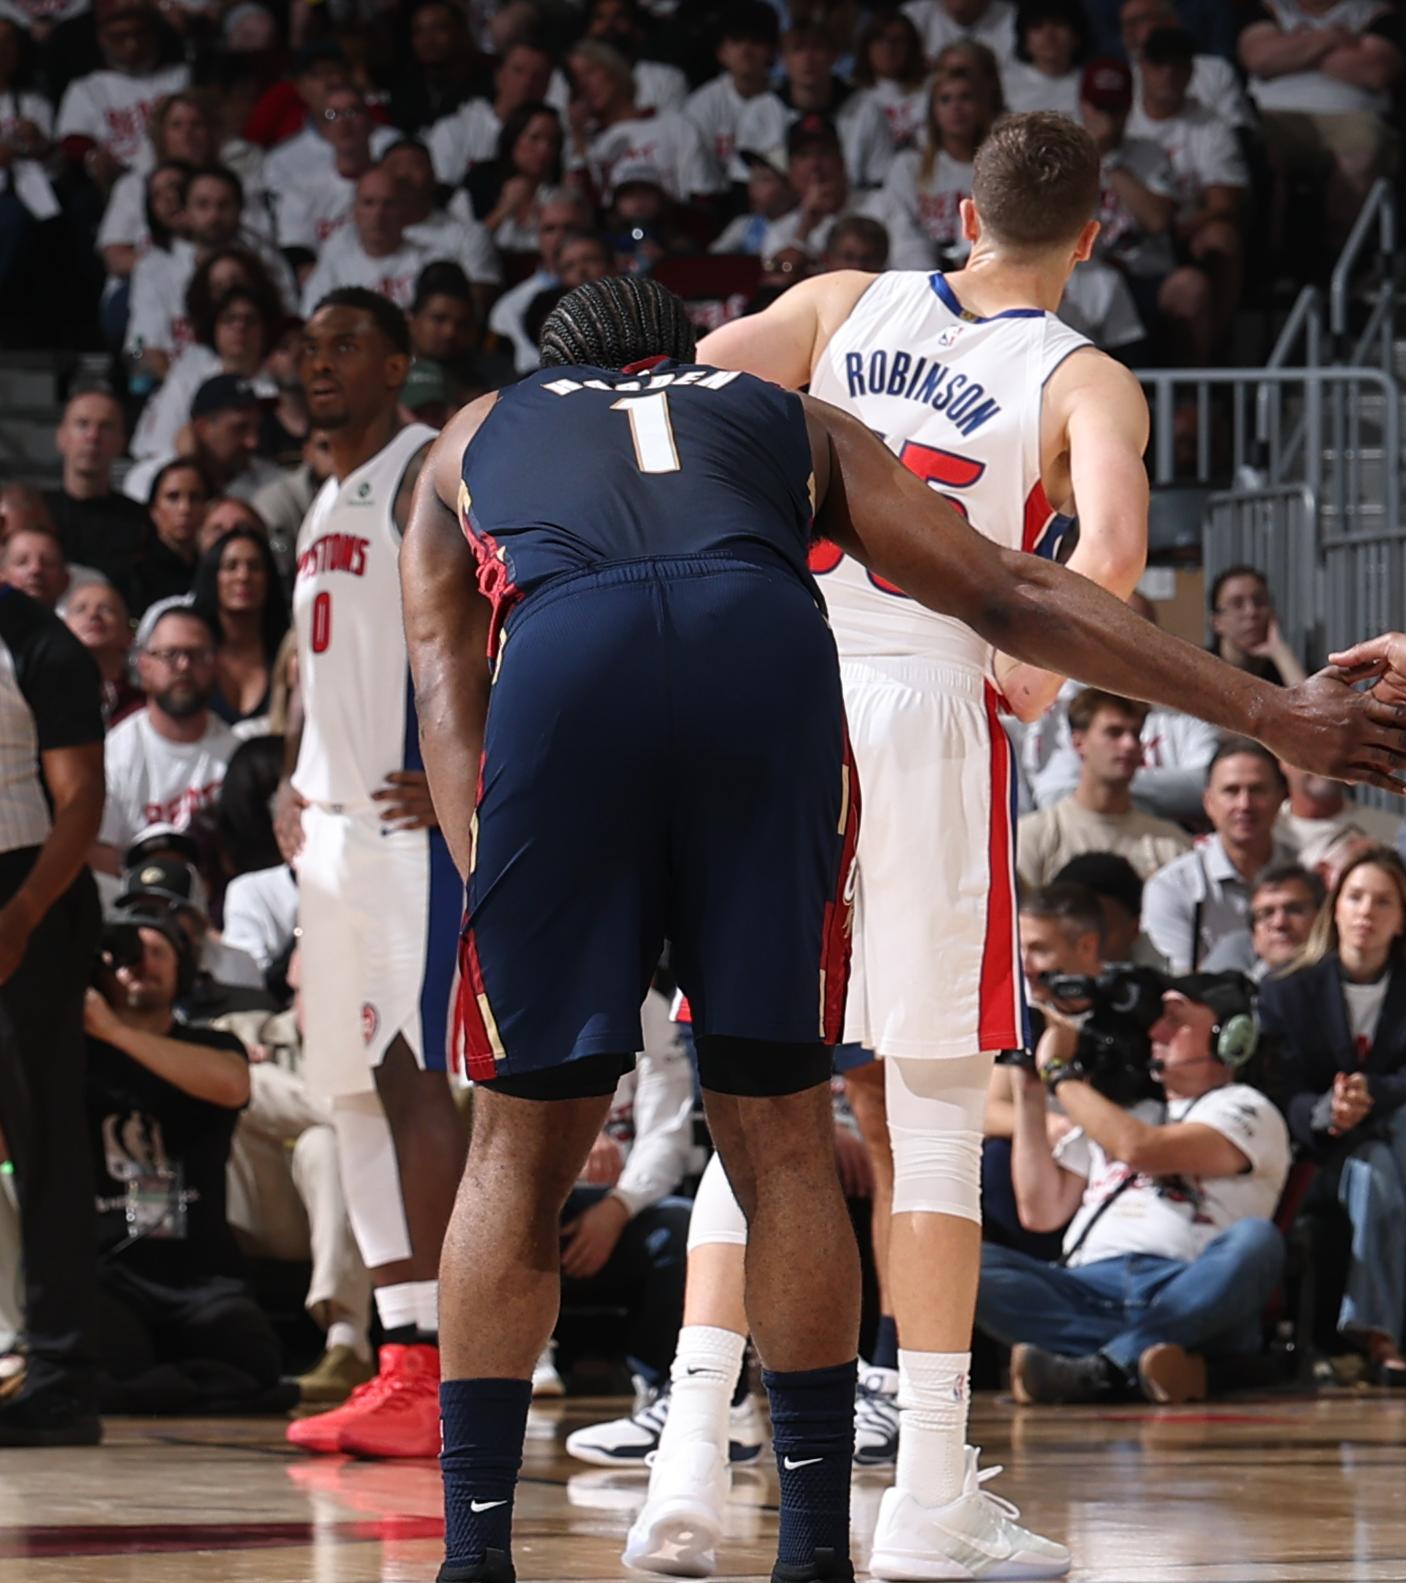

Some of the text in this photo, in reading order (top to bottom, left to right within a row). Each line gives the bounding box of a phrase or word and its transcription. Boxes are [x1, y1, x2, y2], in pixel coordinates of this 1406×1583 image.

[608, 390, 681, 474] 1
[845, 349, 1002, 437] ROBINSON
[311, 591, 332, 654] 0
